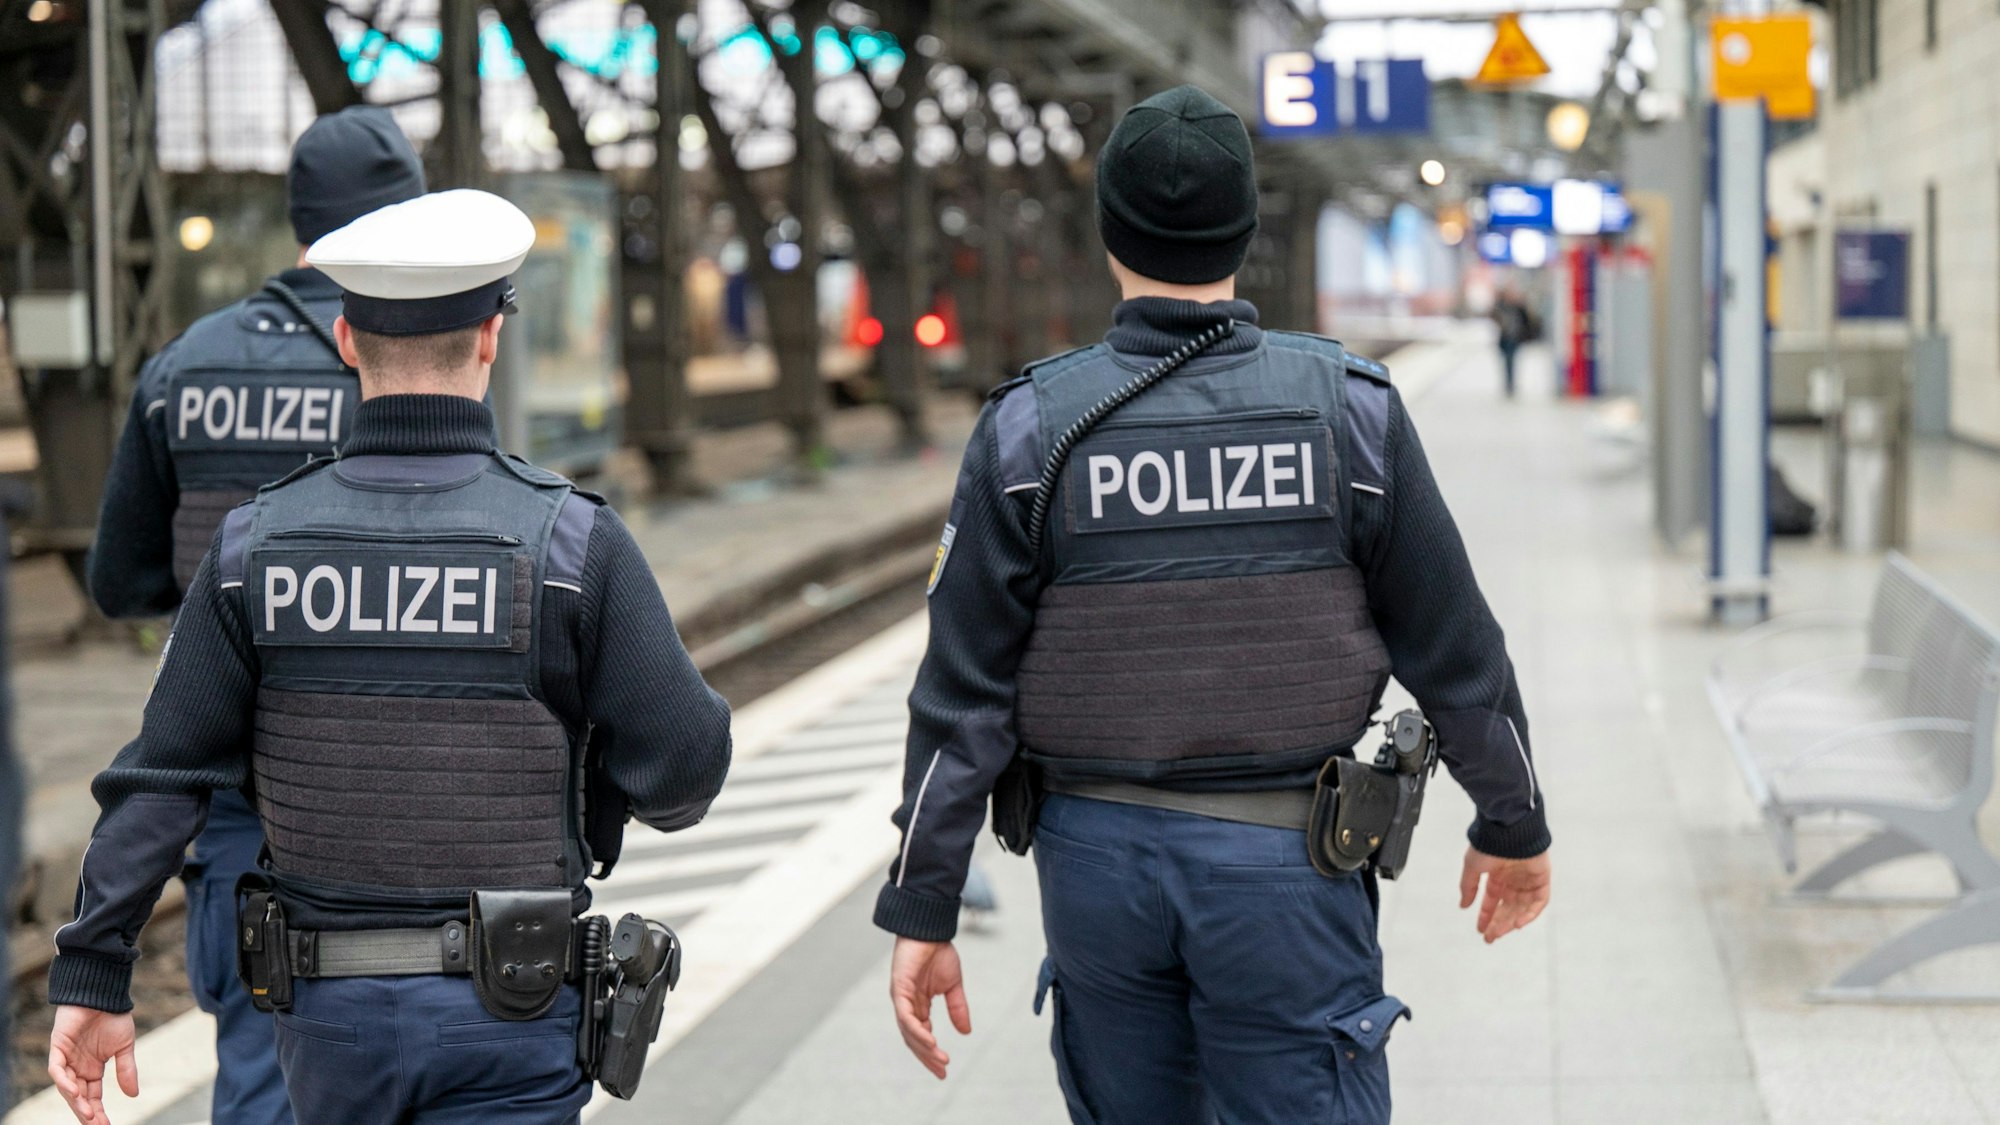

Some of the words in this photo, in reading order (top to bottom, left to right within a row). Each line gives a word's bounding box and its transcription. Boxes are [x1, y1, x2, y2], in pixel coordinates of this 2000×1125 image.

[1264, 51, 1317, 126] E
[178, 385, 344, 442] POLIZEI
[1088, 442, 1315, 519] POLIZEI
[265, 564, 497, 634] POLIZEI
